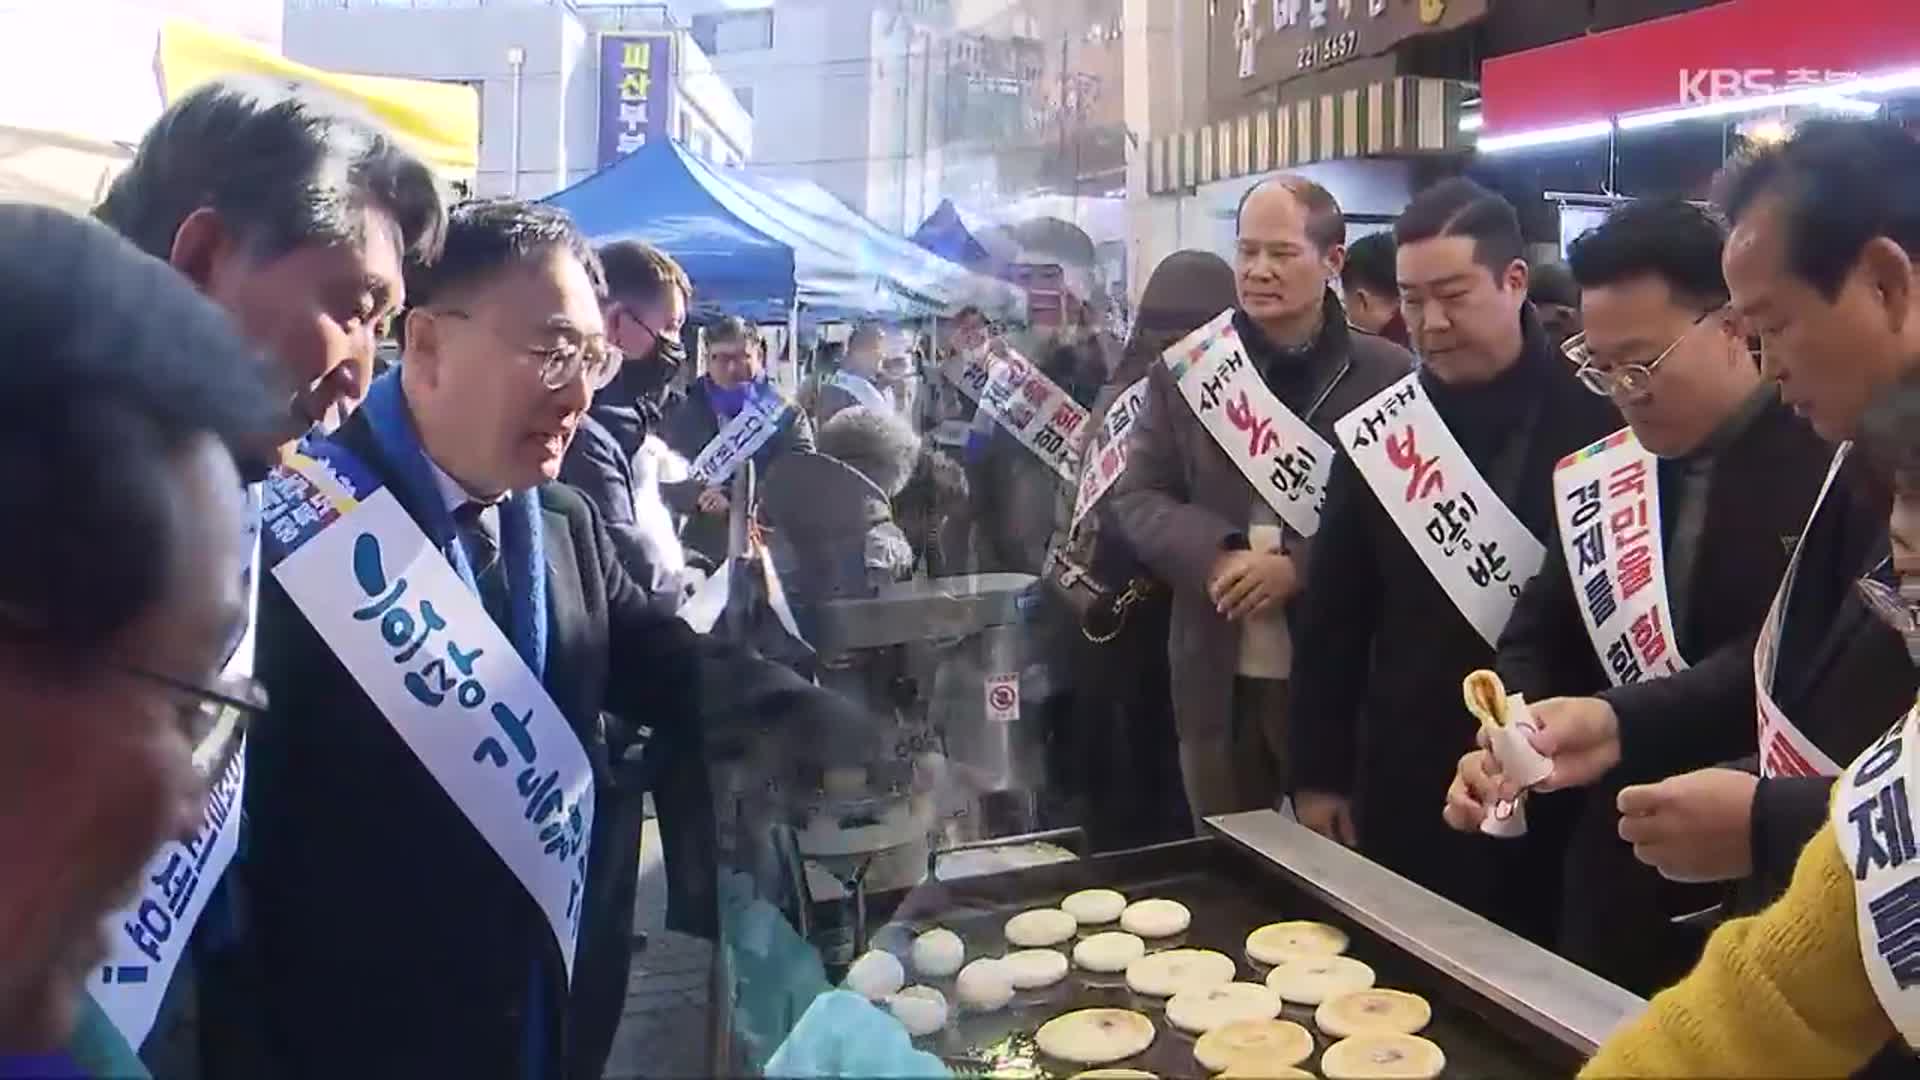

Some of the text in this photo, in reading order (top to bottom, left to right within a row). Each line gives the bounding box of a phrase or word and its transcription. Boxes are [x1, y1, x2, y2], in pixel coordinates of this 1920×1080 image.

[1201, 350, 1244, 412] 새해
[1226, 388, 1281, 457] 복
[1353, 384, 1416, 450] 새해
[1385, 424, 1443, 502] 복
[1425, 491, 1478, 557] 많이
[1566, 479, 1617, 629] 경제를
[1608, 459, 1676, 672] 국민을 힘
